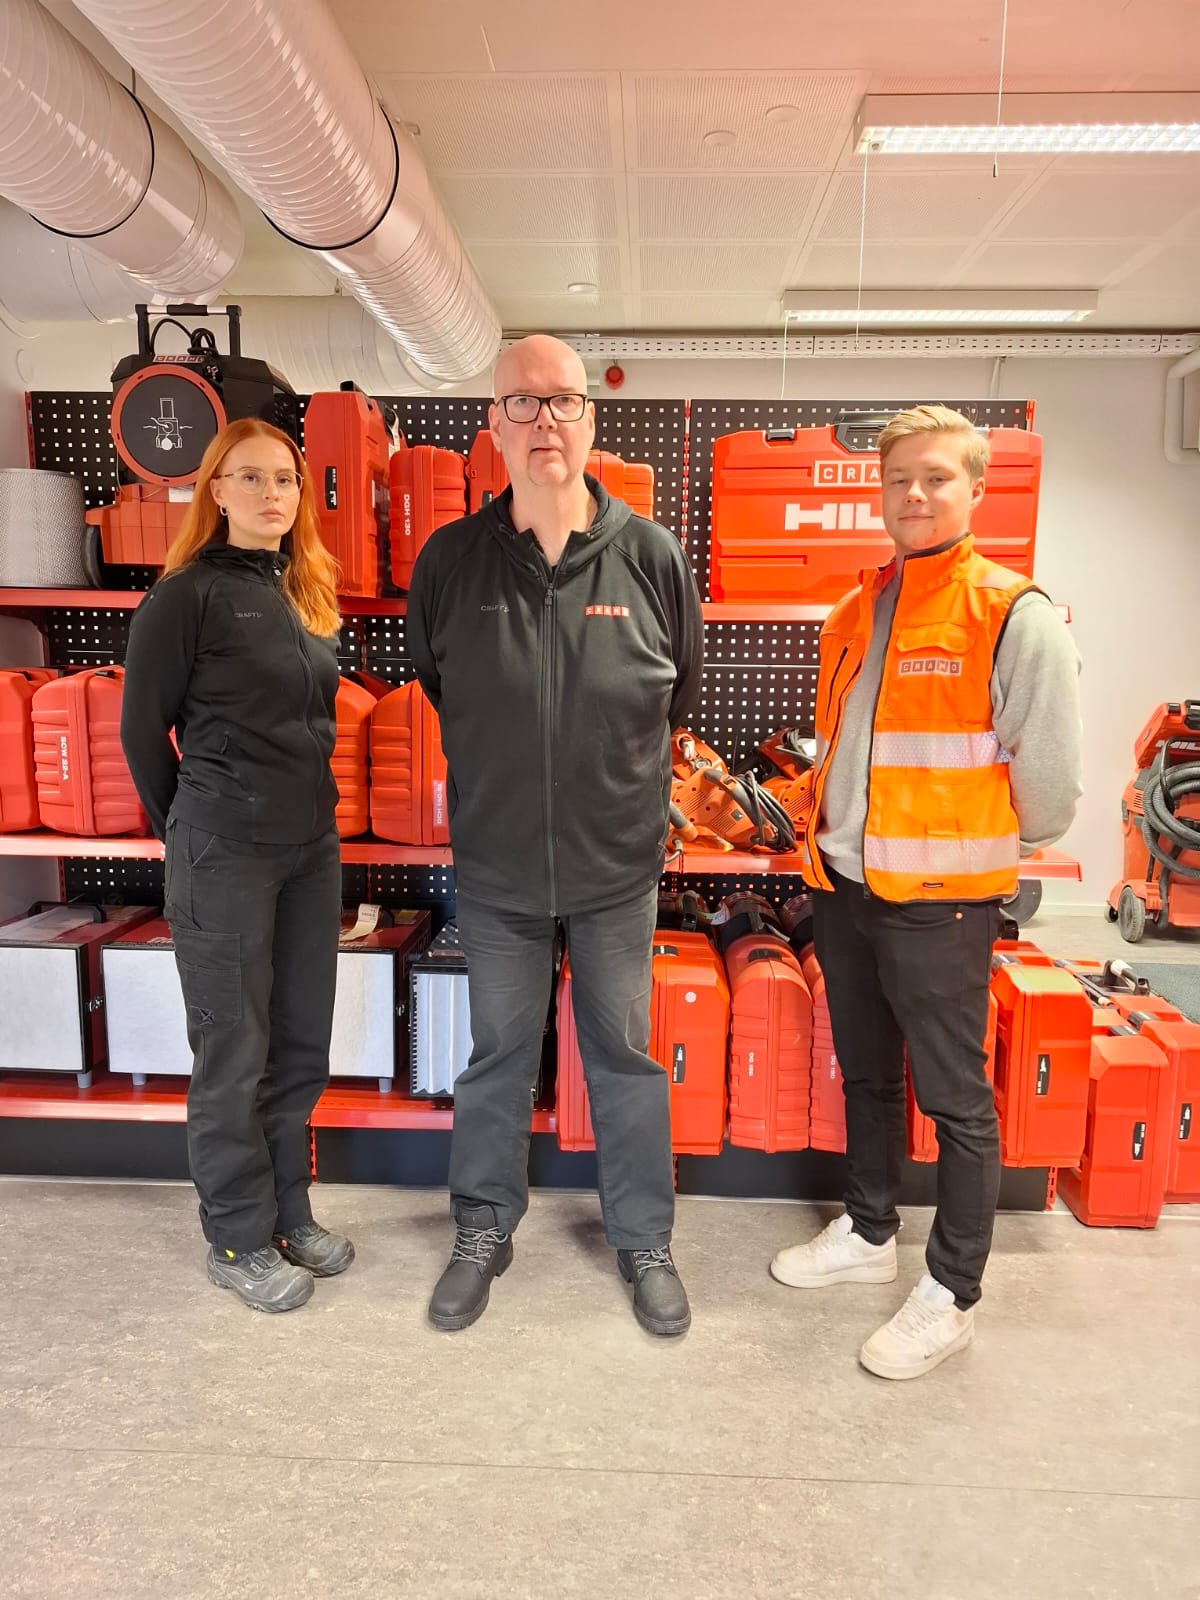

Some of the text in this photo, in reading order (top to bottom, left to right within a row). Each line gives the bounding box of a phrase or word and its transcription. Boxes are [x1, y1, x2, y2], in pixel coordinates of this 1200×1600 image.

[821, 466, 881, 481] CRA
[785, 503, 885, 530] HIL
[901, 661, 960, 673] CRAMO
[1156, 740, 1200, 750] HIL
